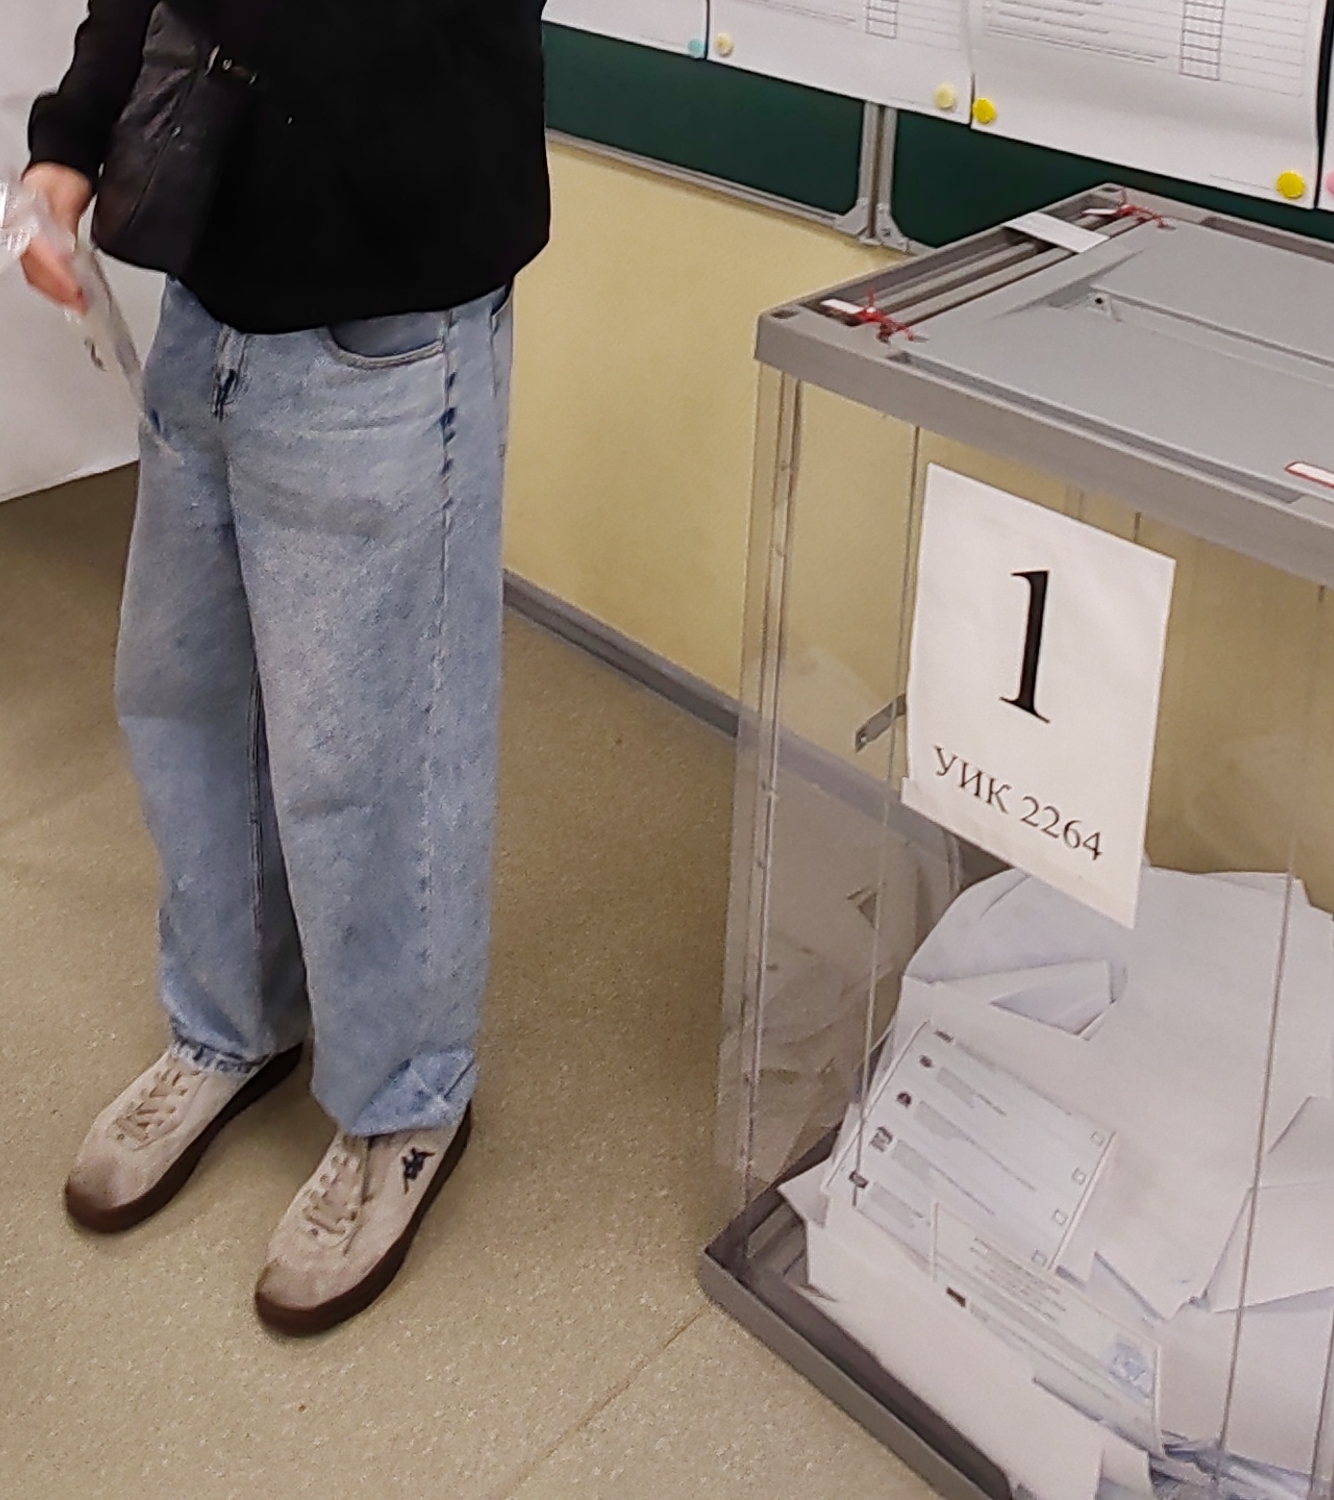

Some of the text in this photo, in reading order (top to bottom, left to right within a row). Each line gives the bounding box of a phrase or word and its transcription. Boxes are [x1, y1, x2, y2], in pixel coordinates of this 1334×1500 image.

[998, 569, 1052, 725] 1
[932, 743, 1104, 861] УИК 2264
